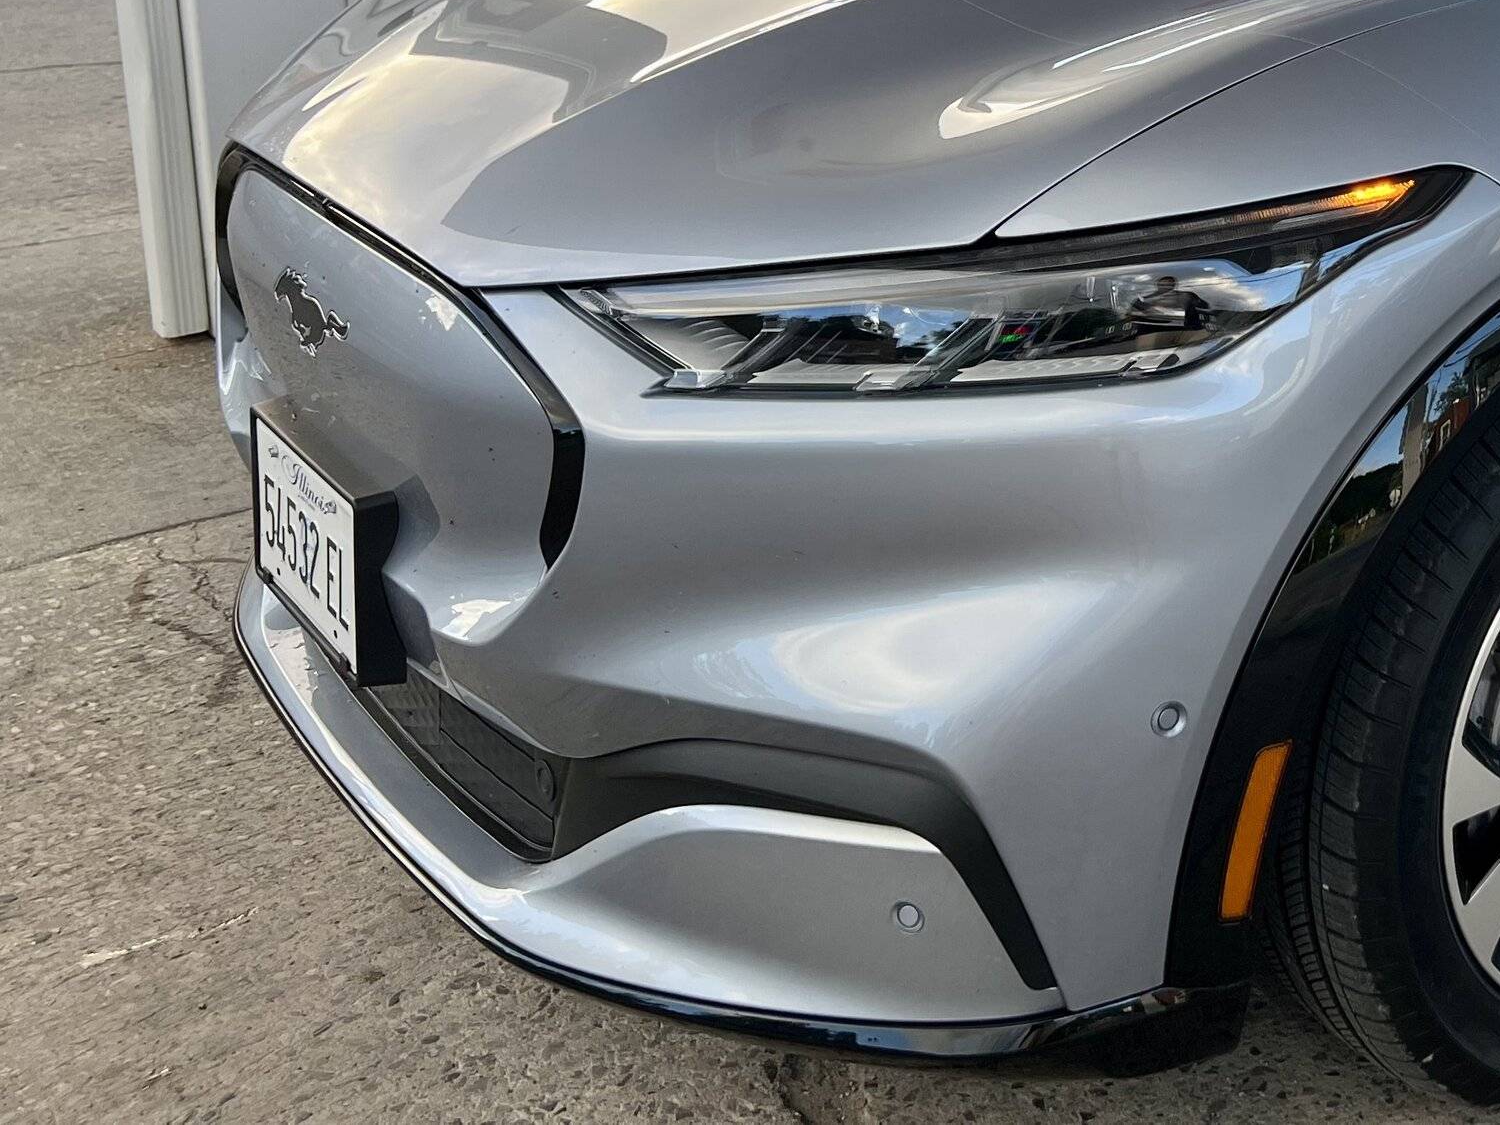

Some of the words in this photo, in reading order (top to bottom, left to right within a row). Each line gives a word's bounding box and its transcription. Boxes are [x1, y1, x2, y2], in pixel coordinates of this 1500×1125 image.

[281, 454, 328, 516] Illinois
[264, 474, 320, 600] 54532
[326, 535, 350, 632] EL
